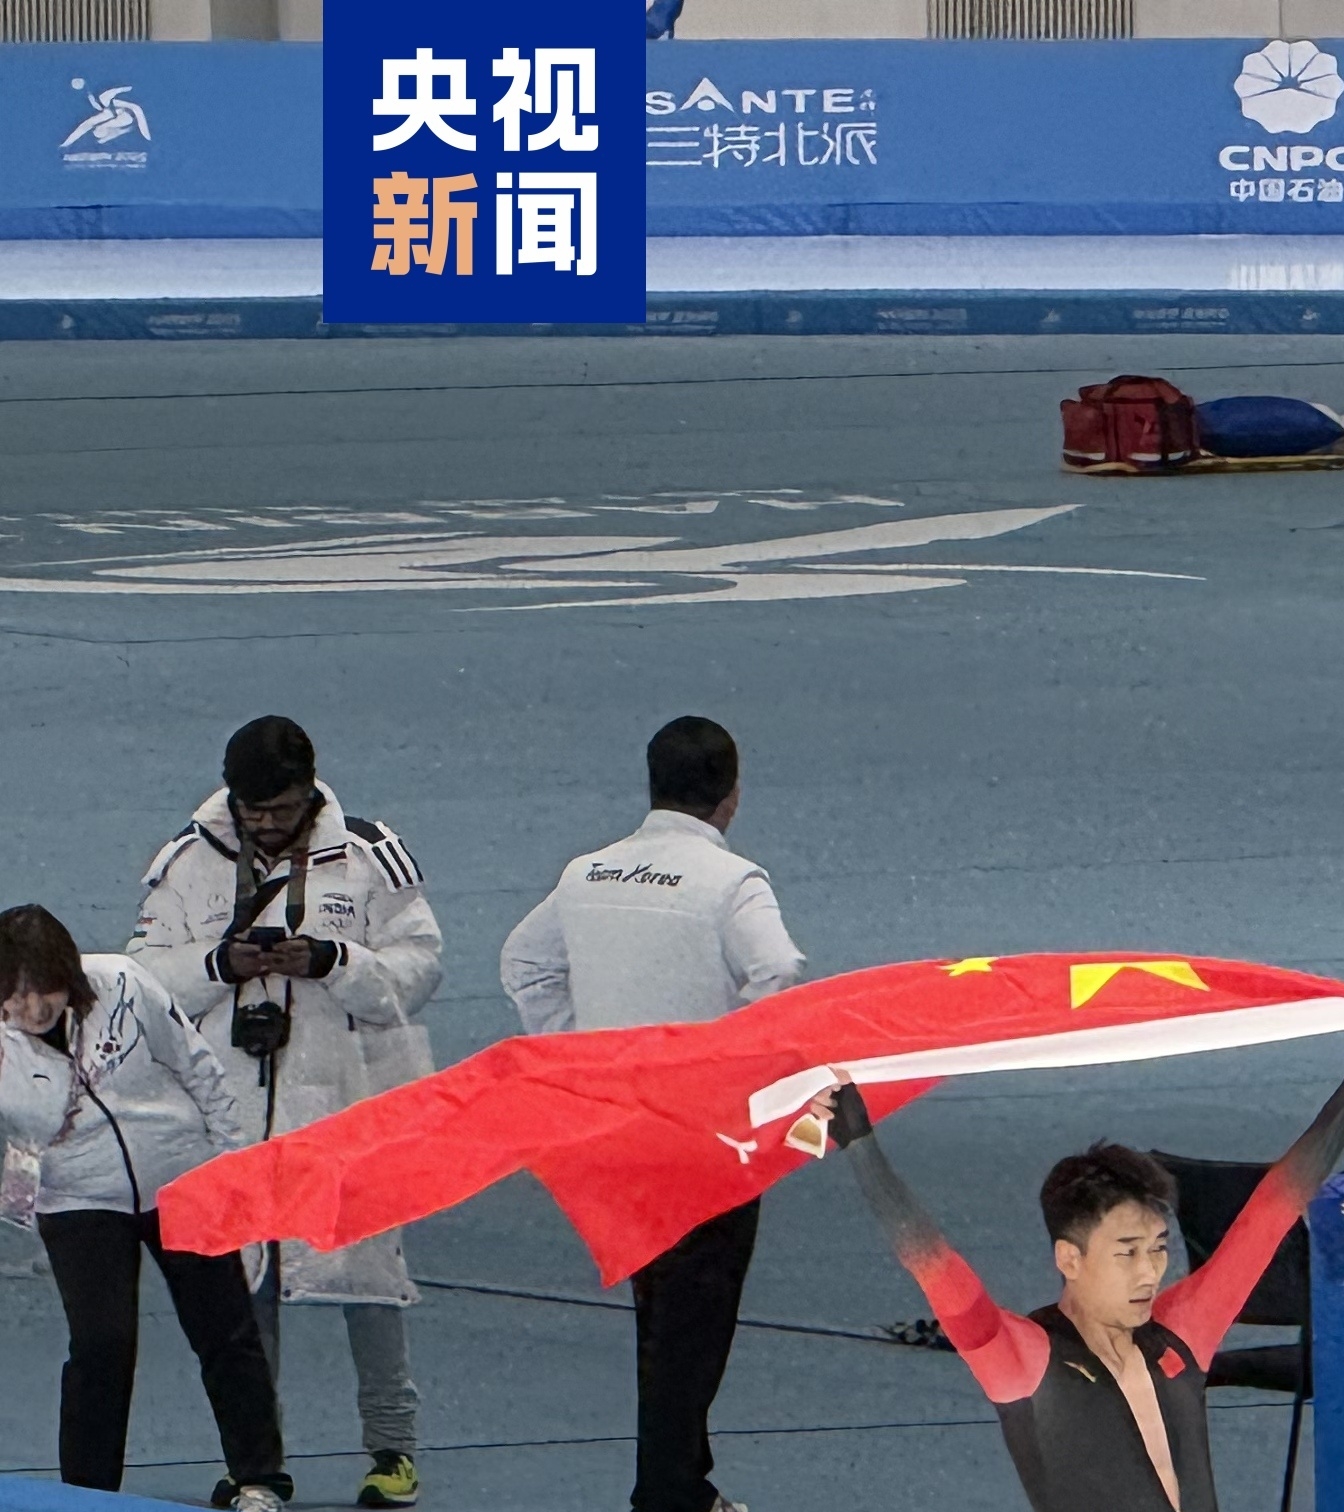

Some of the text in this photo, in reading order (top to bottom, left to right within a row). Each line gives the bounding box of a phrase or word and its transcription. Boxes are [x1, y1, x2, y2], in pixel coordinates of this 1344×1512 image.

[646, 122, 877, 168] 三特北派
[1230, 178, 1344, 202] 中国石油
